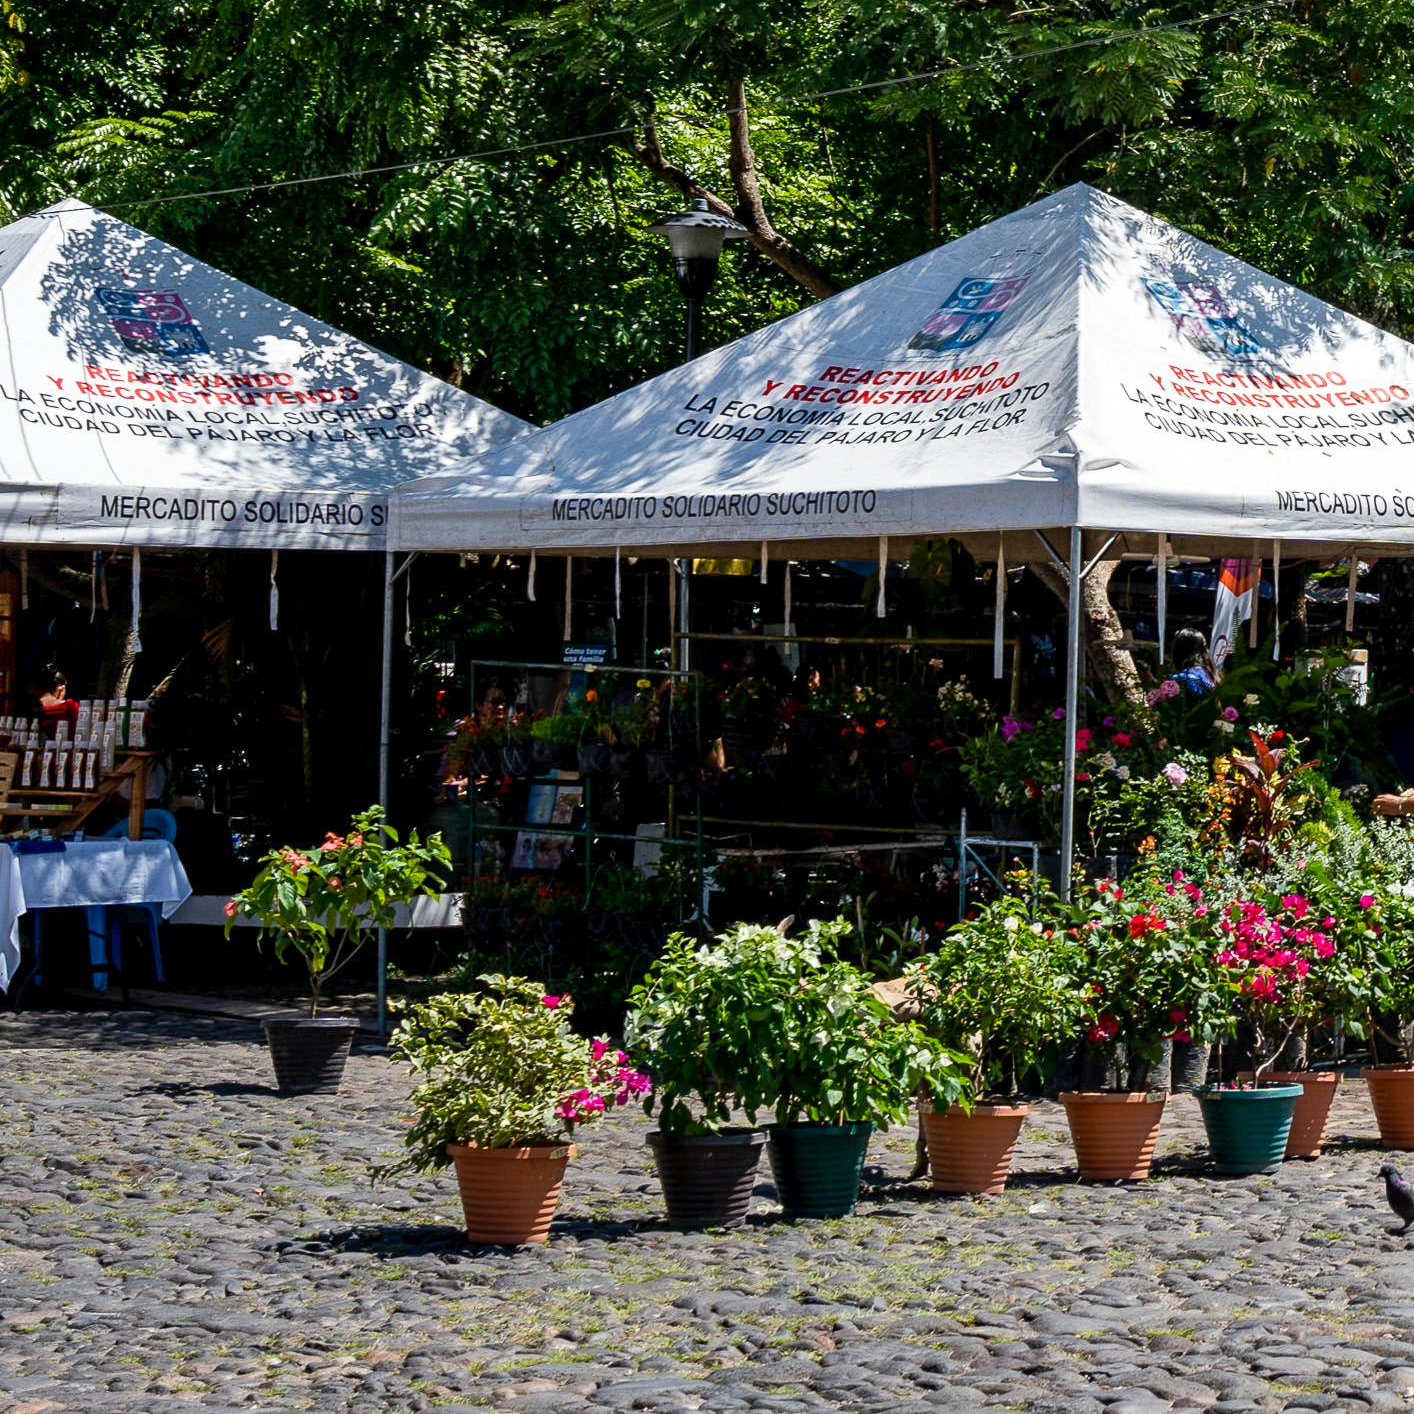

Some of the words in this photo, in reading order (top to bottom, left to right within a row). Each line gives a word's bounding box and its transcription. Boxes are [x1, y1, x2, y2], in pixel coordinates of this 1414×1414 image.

[84, 364, 294, 389] REACTIVANDO
[761, 379, 783, 397] Y
[784, 372, 1020, 405] RECONSTRUYENDO
[819, 361, 1000, 387] REACTIVANDO
[1168, 364, 1347, 390] REACTIVANDO
[0, 384, 36, 405] LA
[46, 374, 64, 391] Y
[76, 380, 359, 407] RECONSTRUYENDO
[1120, 383, 1149, 406] LA
[1150, 372, 1165, 391] Y
[1172, 381, 1411, 409] RECONSTRUYENDO
[684, 393, 713, 414] LA
[720, 399, 846, 426] ECONOMÍA
[19, 408, 121, 435] CIUDAD
[128, 423, 183, 440] DEL
[322, 430, 356, 443] LA
[675, 418, 765, 443] CIUDAD
[765, 426, 808, 445] DEL
[914, 428, 932, 443] Y
[930, 424, 963, 441] LA
[1144, 411, 1228, 444] CIUDAD
[1228, 431, 1278, 448] DEL
[1372, 432, 1389, 446] Y
[101, 495, 237, 522] MERCADITO
[244, 500, 364, 526] SOLIDARIO
[552, 496, 656, 521] MERCADITO
[662, 493, 761, 519] SOLIDARIO
[766, 490, 877, 516] SUCHITOTO
[1274, 490, 1388, 516] MERCADITO
